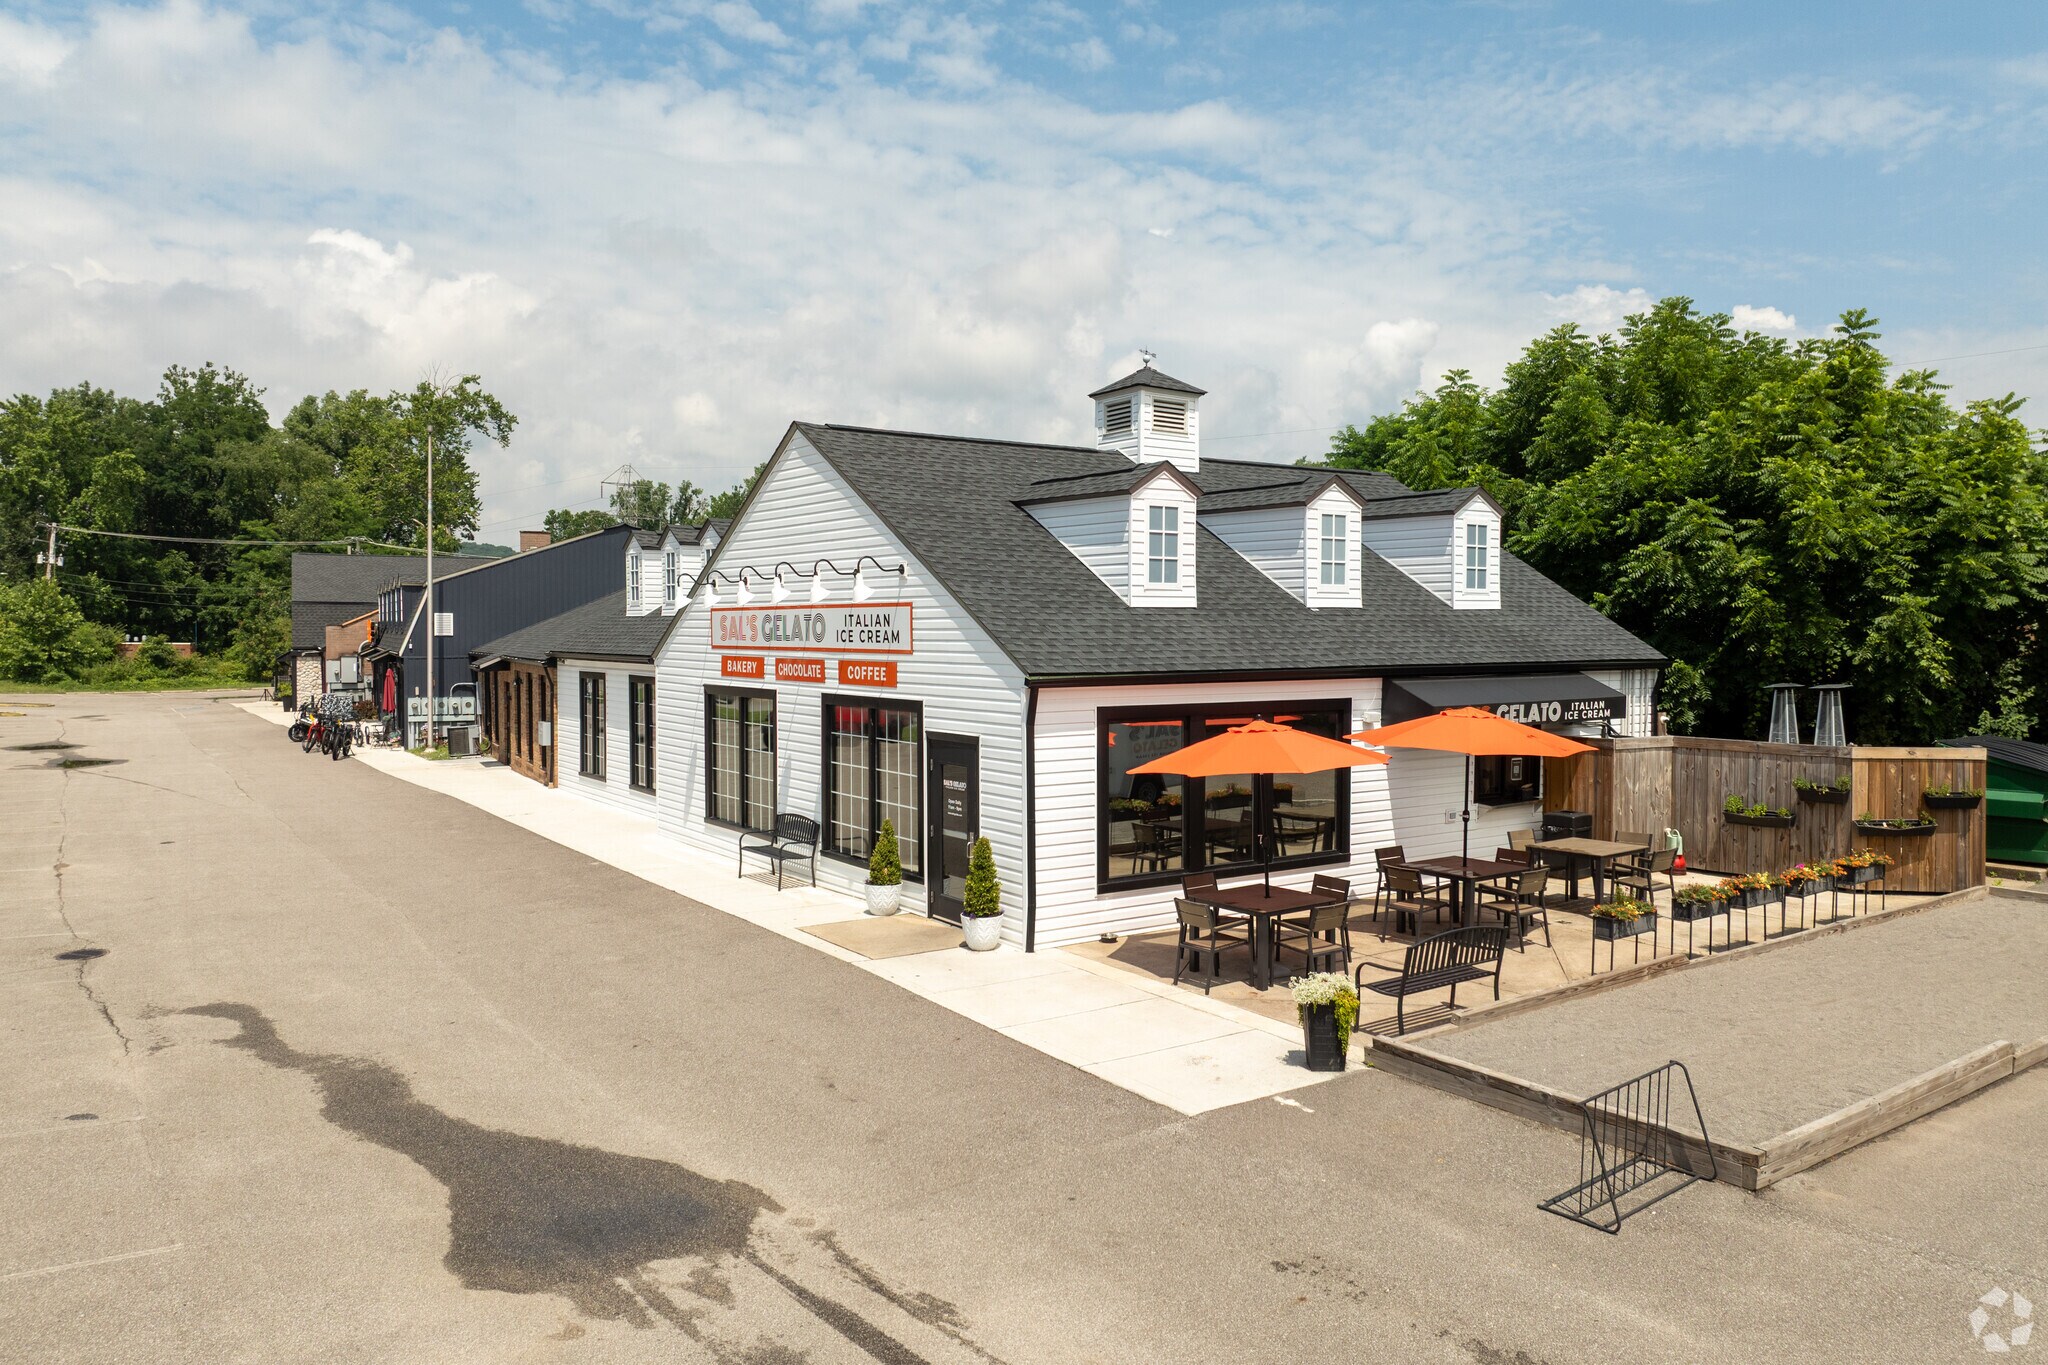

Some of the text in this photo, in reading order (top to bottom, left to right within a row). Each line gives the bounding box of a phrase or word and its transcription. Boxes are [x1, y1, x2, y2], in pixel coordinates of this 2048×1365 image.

[720, 612, 826, 643] SAL'S GELATO
[844, 613, 891, 628] ITALIAN
[836, 629, 900, 644] ICE CREAM
[727, 660, 757, 674] BAKERY
[778, 663, 822, 678] CHOCOLATE
[847, 665, 887, 681] COFFEE
[1496, 701, 1561, 723] GELATO
[1571, 700, 1605, 711] ITALIAN
[1564, 708, 1611, 720] ICE CREAM
